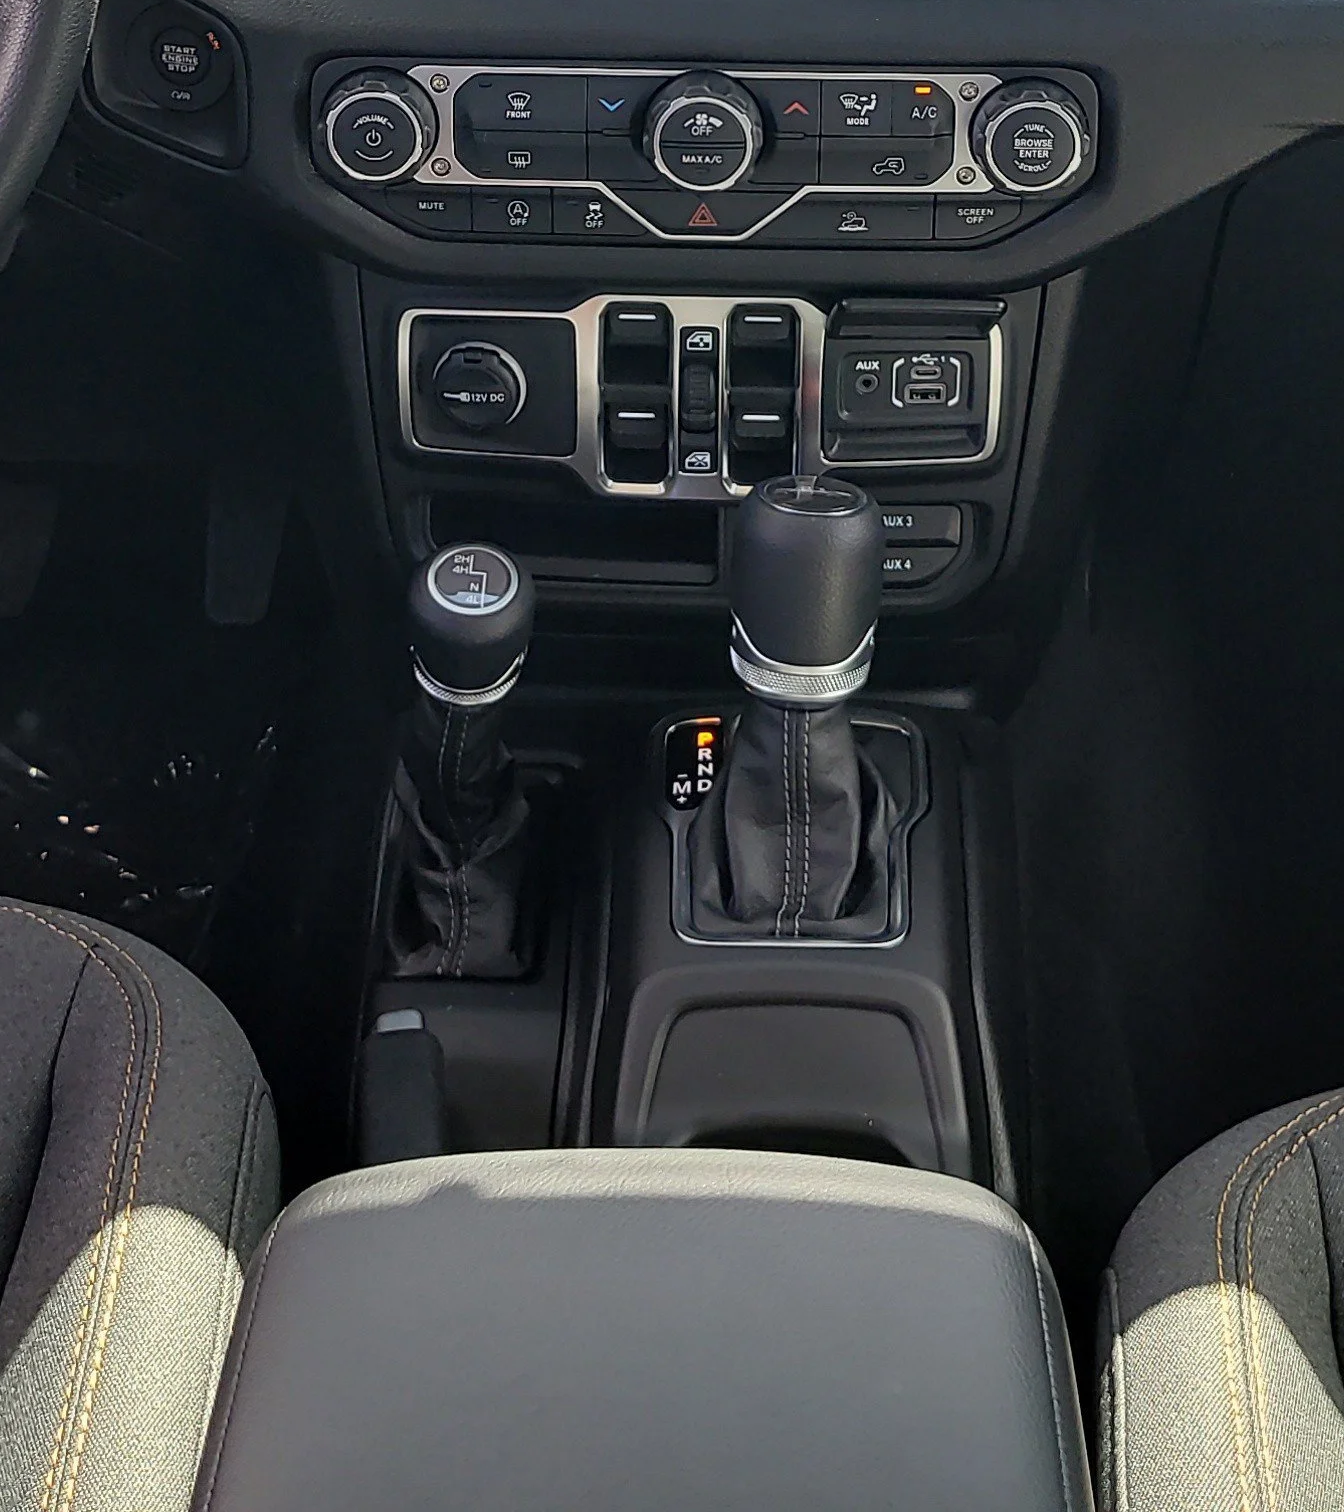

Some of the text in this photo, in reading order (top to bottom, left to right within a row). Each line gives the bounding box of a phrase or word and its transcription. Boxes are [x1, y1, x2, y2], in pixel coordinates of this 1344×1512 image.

[163, 45, 196, 54] START
[505, 110, 531, 119] FRONT
[911, 105, 937, 120] A/C
[846, 117, 869, 126] MODE
[691, 126, 713, 136] OFF
[1024, 124, 1045, 132] TUNE
[1014, 139, 1053, 147] BROWSE
[1019, 150, 1049, 158] ENTER
[682, 155, 722, 163] MAX A/C
[419, 201, 445, 210] MUTE
[958, 207, 994, 217] SCREEN
[509, 217, 528, 226] OFF
[585, 219, 604, 229] OFF
[966, 215, 984, 224] OFF
[856, 361, 880, 371] AUX
[471, 392, 505, 402] 12V DC
[906, 516, 914, 527] 3
[455, 555, 469, 563] 2H
[883, 559, 912, 570] UX 4
[470, 583, 479, 591] N
[467, 595, 479, 603] 4L
[698, 732, 713, 746] P
[698, 748, 712, 760] R
[698, 763, 713, 776] N
[673, 781, 691, 795] M
[697, 779, 712, 792] D
